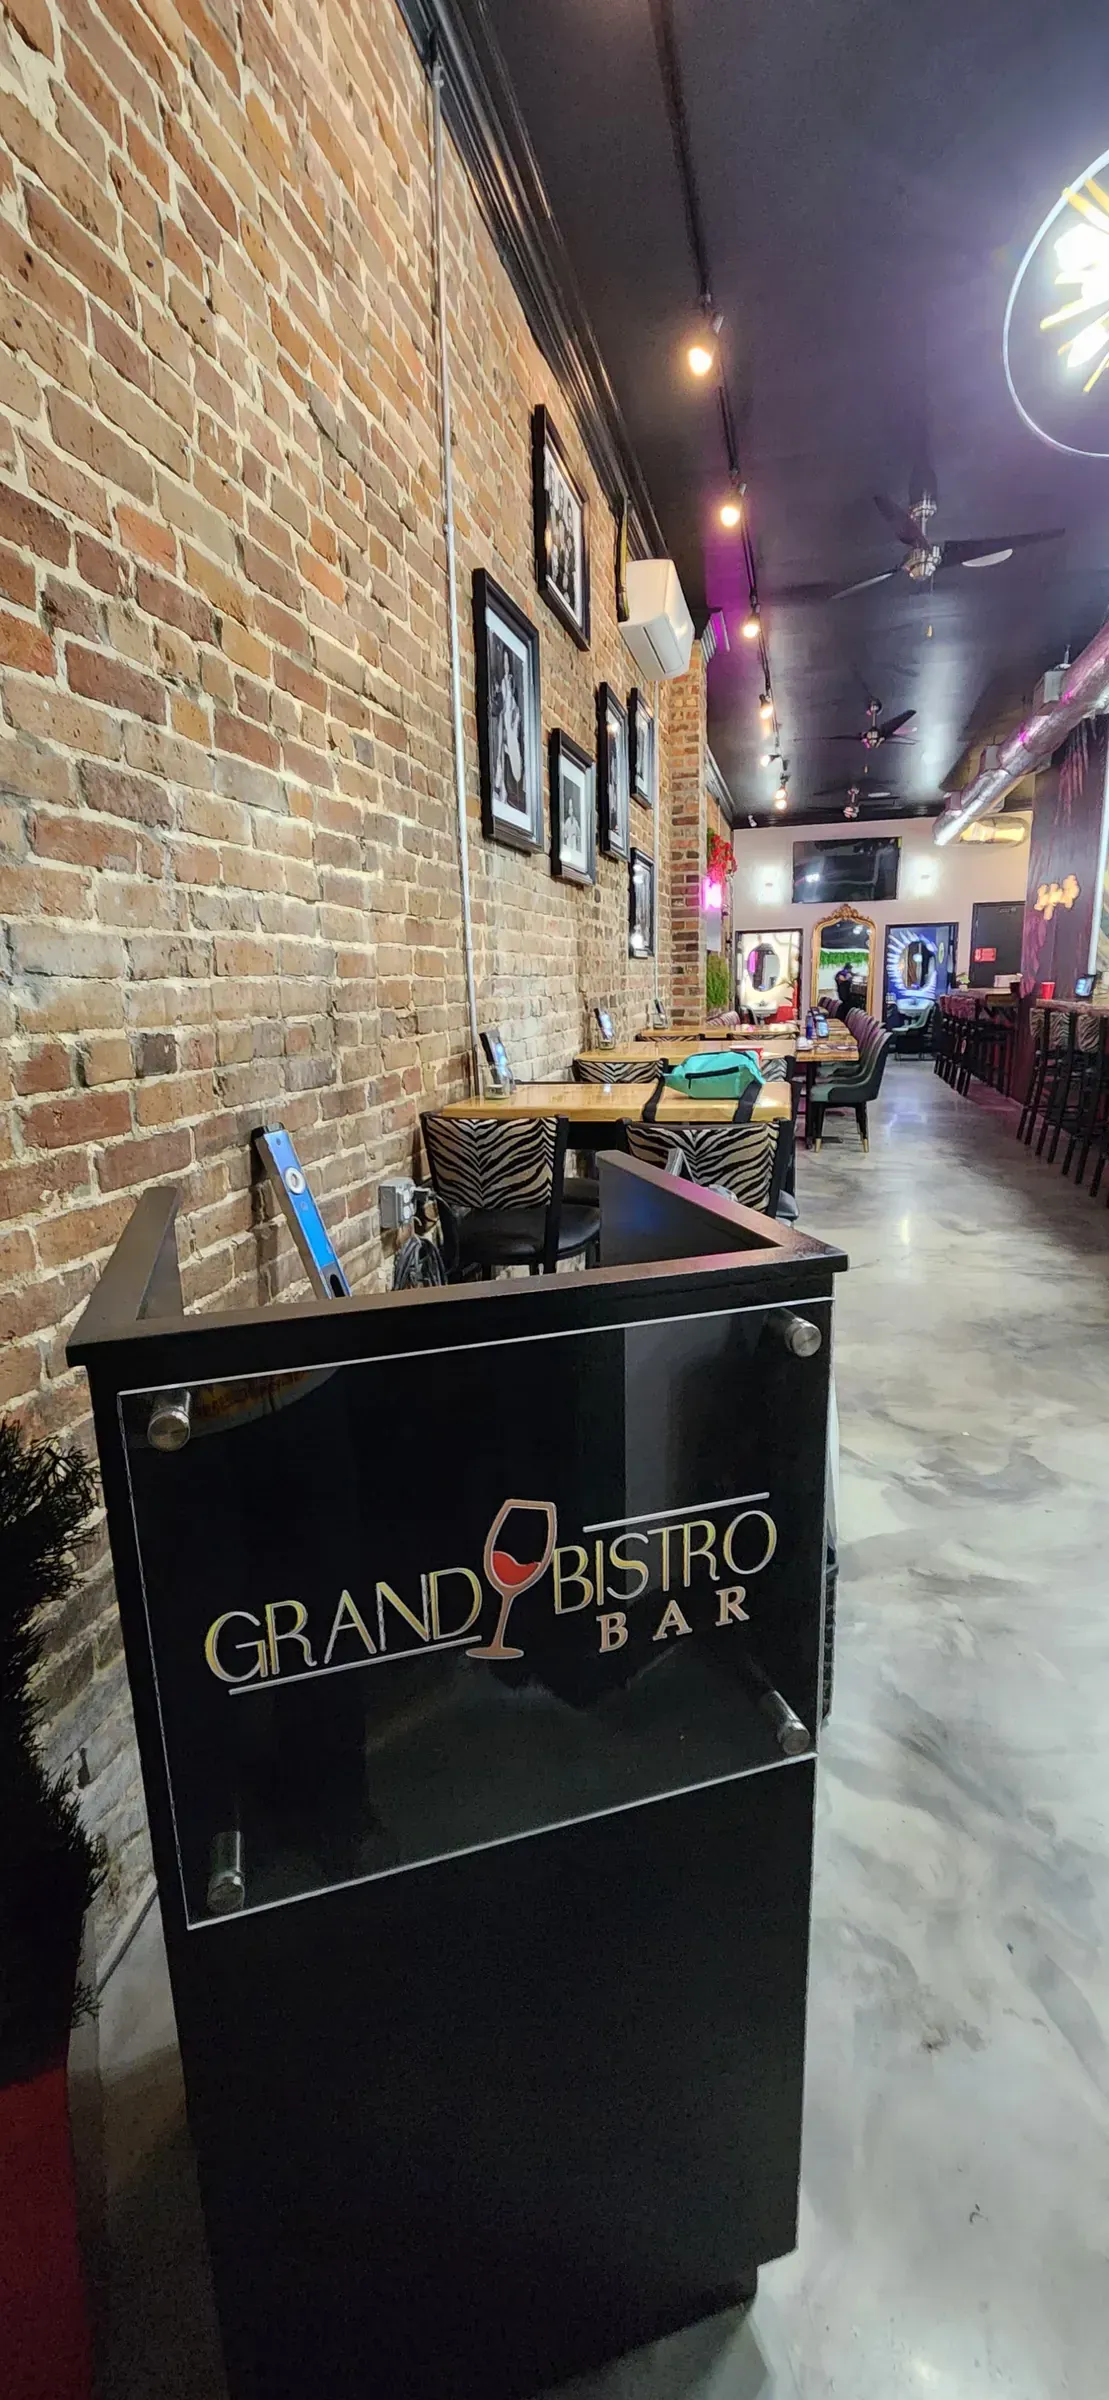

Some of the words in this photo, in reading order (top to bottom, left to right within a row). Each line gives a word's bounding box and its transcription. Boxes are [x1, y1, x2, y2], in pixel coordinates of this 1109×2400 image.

[205, 1567, 482, 1682] GRAND
[552, 1510, 777, 1614] BISTRO
[596, 1585, 750, 1653] BAR
